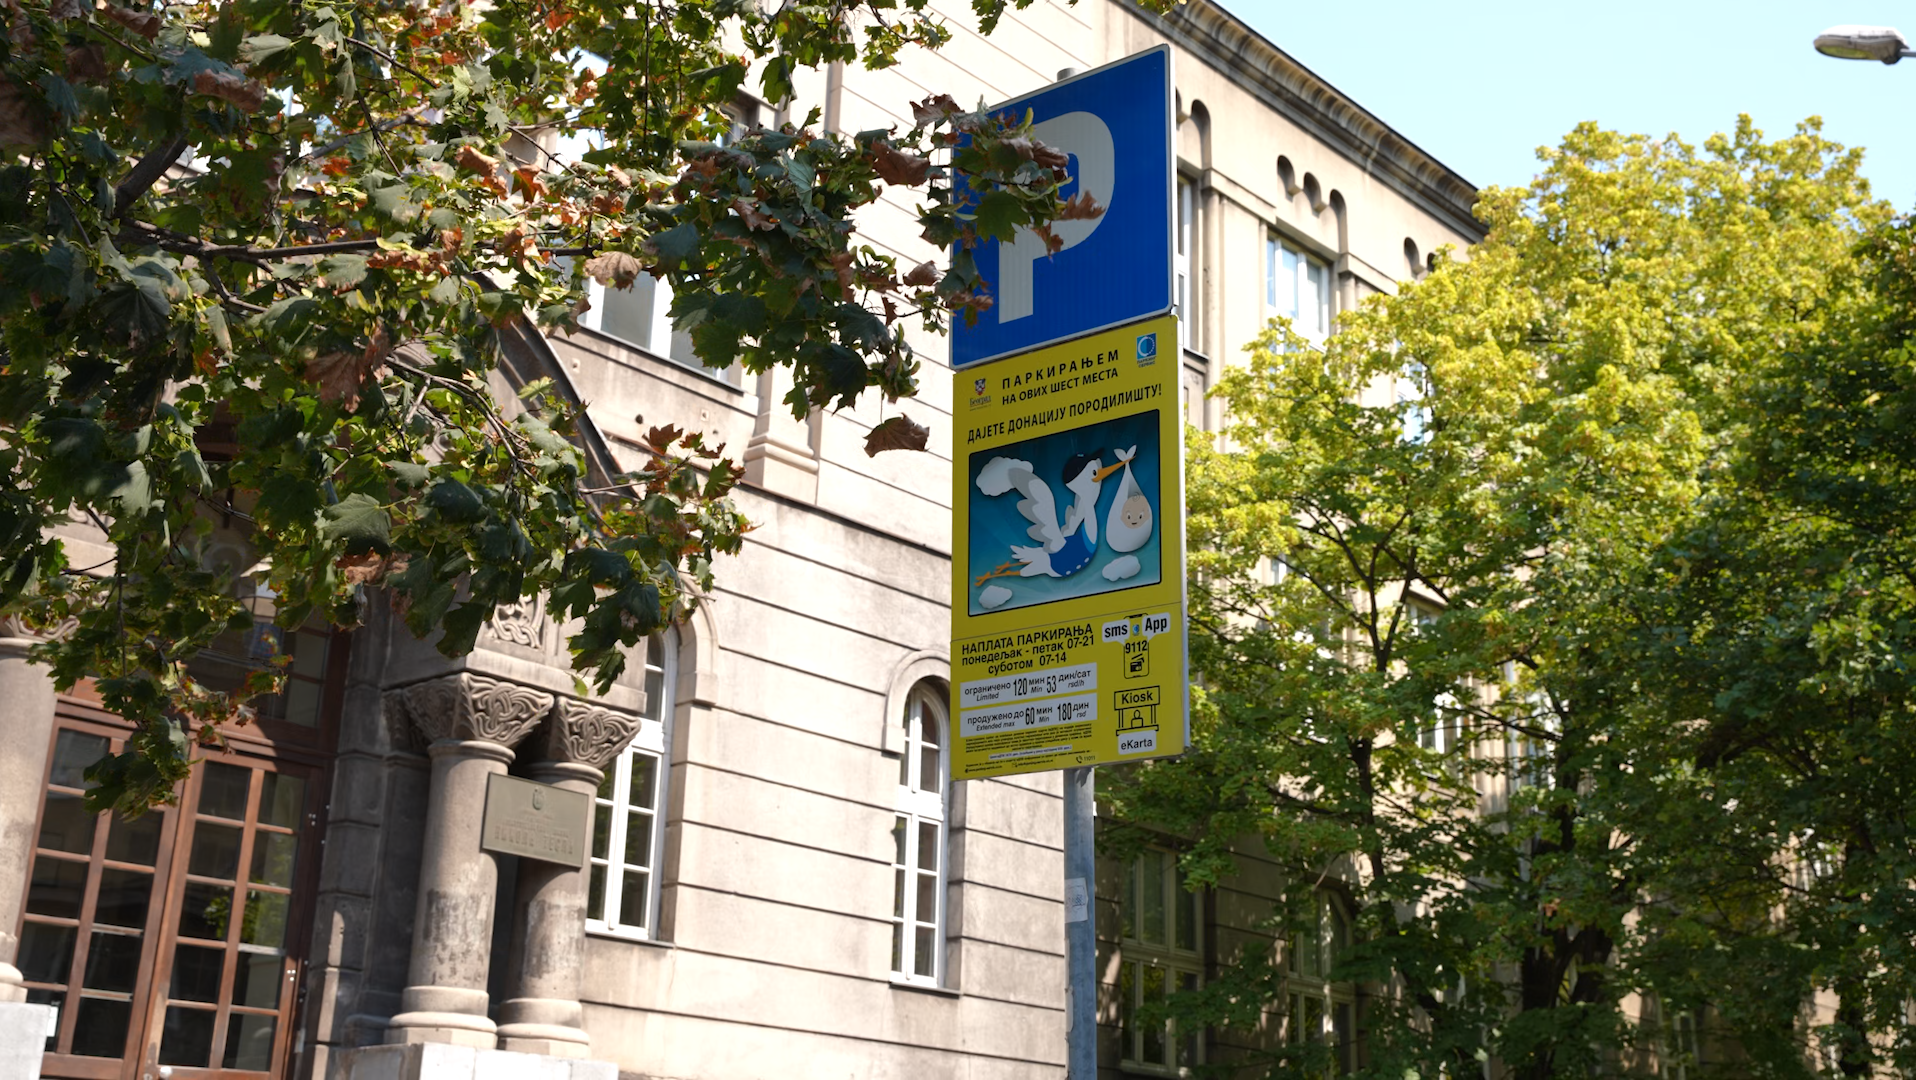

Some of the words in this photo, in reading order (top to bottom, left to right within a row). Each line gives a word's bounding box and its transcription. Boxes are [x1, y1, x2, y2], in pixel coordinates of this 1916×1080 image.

[998, 111, 1115, 325] P
[1002, 349, 1119, 390] ПАРКИРАЊЕМ
[1002, 394, 1016, 405] НА
[1019, 386, 1047, 401] ОВИХ
[1050, 378, 1080, 392] ШЕСТ
[1083, 368, 1118, 385] МЕСТА
[967, 423, 1005, 444] ДАЈЕТЕ
[1008, 407, 1066, 434] ДОНАЦИЈУ
[1069, 383, 1162, 418] ПОРОДИЛИШТУ!
[1104, 624, 1128, 638] sms
[1145, 617, 1167, 633] App
[962, 636, 1013, 655] НАПЛАТА
[1017, 623, 1093, 647] ПАРКИРАЊА
[962, 645, 1022, 666] понедељак
[1033, 641, 1064, 656] петак
[1067, 634, 1094, 650] 07-21
[1125, 640, 1148, 654] 9112
[988, 660, 1033, 675] суботом
[1039, 652, 1067, 667] 07-14
[964, 681, 1011, 696] ограничено
[1013, 677, 1028, 696] 120
[1029, 677, 1045, 686] мин
[1047, 675, 1057, 694] 53
[1058, 670, 1091, 683] дин/сат
[977, 692, 999, 701] Limited
[1068, 679, 1085, 688] rsd/h
[1121, 691, 1153, 704] Kiosk
[967, 712, 1013, 725] продужено
[1014, 710, 1024, 720] до
[1025, 707, 1035, 725] 60
[1036, 706, 1052, 715] мин
[1057, 702, 1072, 720] 180
[1073, 702, 1089, 712] дин
[977, 723, 1002, 732] Extended
[1121, 738, 1153, 750] eKarta
